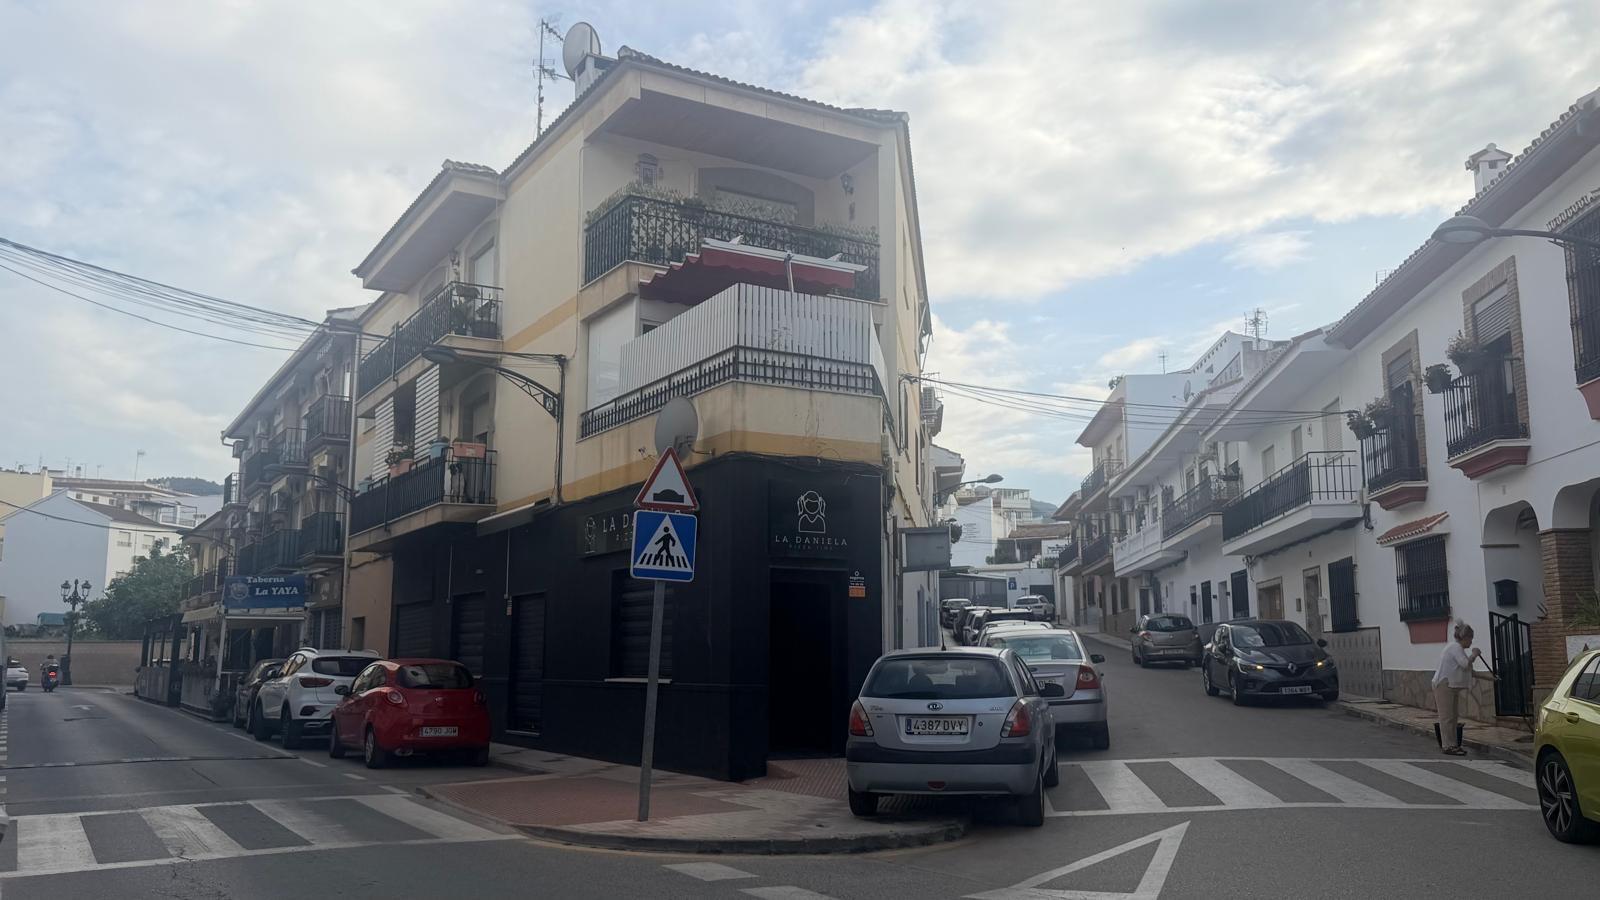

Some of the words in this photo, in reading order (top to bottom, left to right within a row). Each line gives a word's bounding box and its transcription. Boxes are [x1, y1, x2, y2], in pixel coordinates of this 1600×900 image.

[603, 517, 615, 532] LA
[775, 535, 789, 543] LA
[795, 536, 847, 545] DANIELA
[271, 587, 298, 595] YAYA
[913, 720, 941, 731] 4387
[943, 720, 964, 731] DVY
